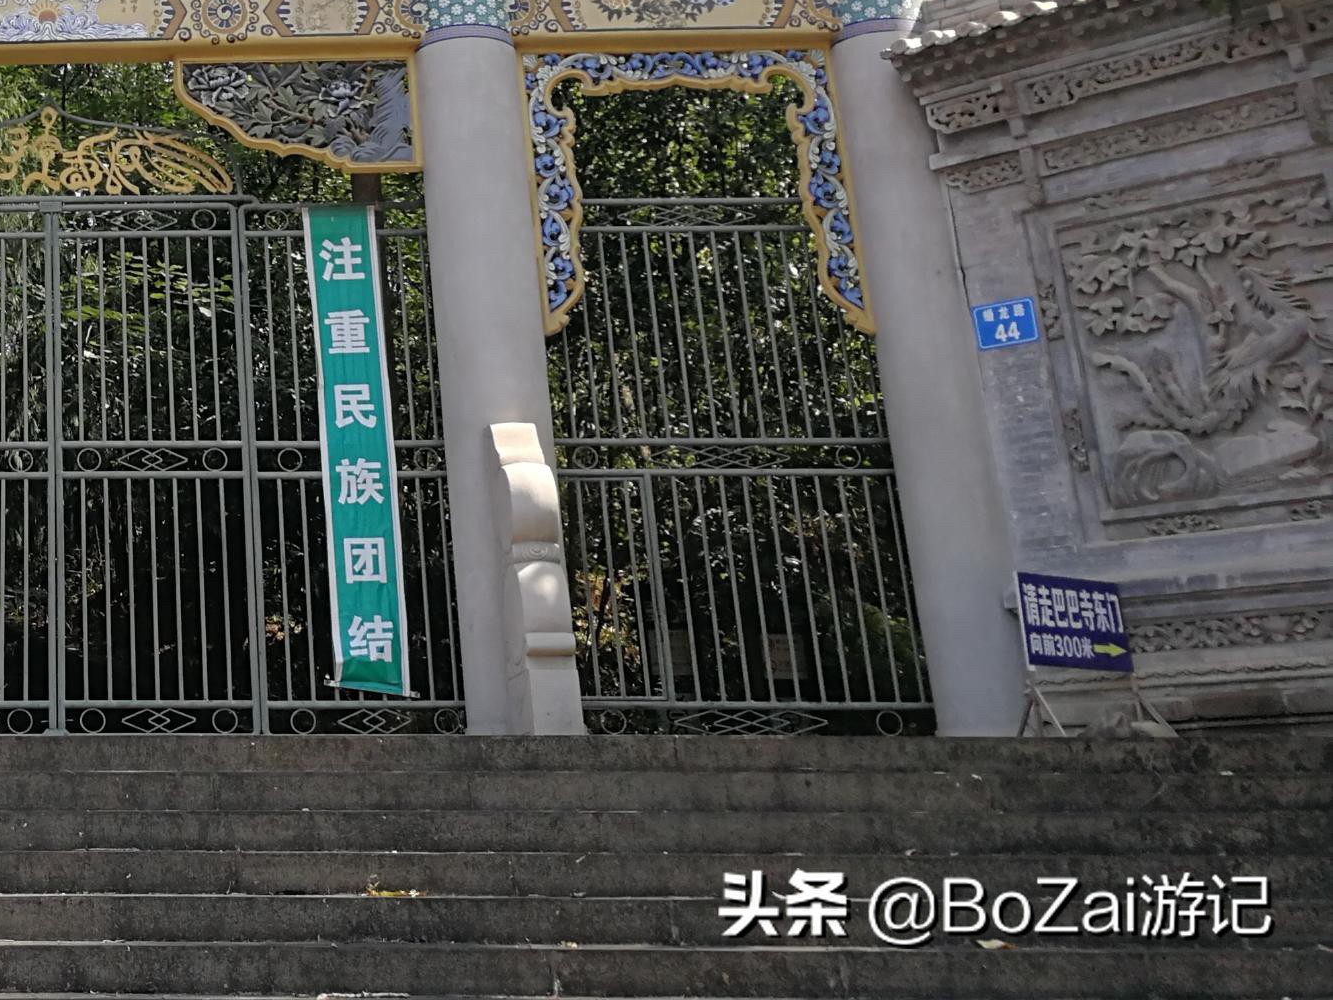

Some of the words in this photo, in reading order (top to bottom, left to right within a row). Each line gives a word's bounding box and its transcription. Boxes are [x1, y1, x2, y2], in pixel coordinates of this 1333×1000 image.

[995, 321, 1021, 342] 44
[318, 237, 394, 663] 注重民族团结
[1022, 582, 1124, 633] 请走巴巴寺东门
[1029, 632, 1095, 659] 向前300米
